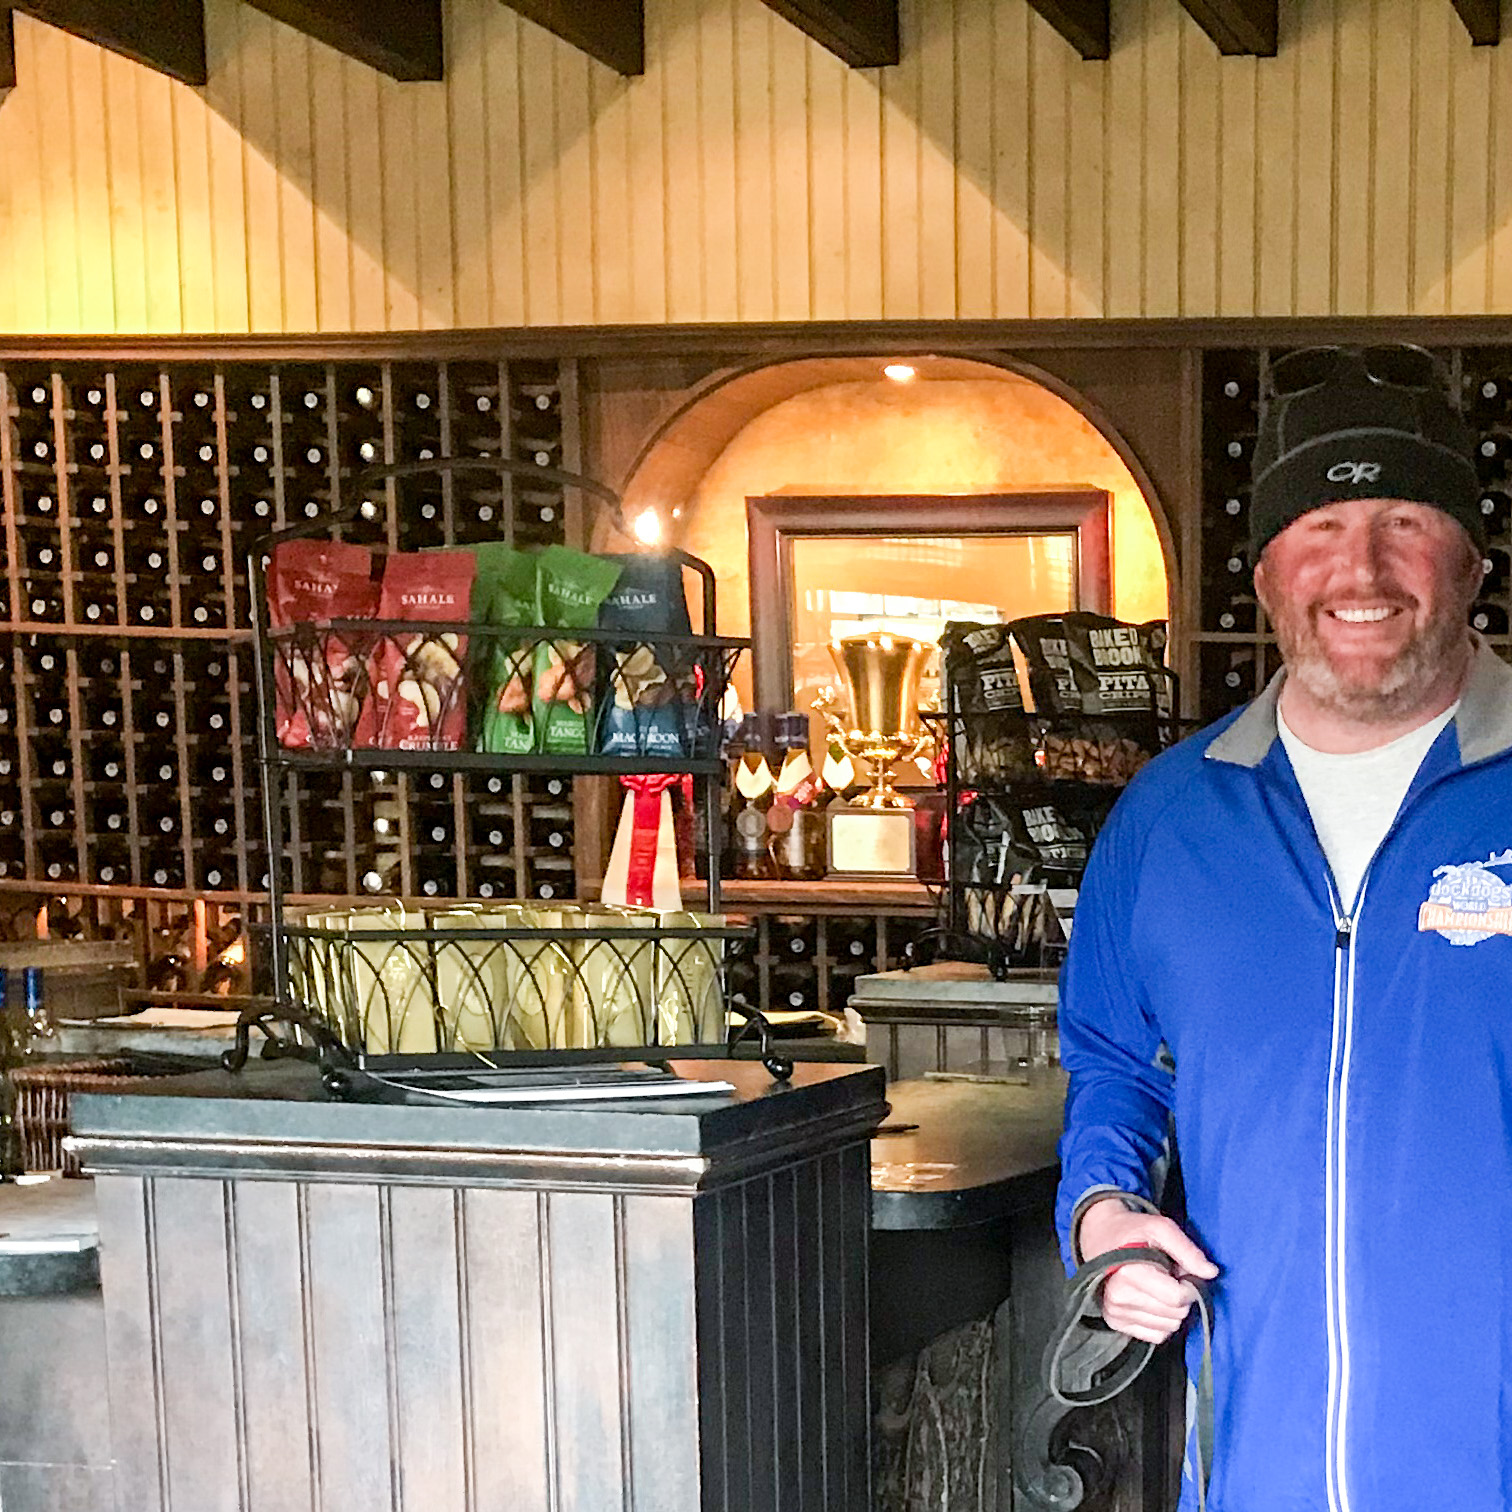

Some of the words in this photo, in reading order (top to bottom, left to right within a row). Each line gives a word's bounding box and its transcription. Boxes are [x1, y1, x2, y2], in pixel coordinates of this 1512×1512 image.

[1327, 461, 1381, 484] OR
[400, 593, 456, 606] SAHALE
[1098, 675, 1150, 691] PITA
